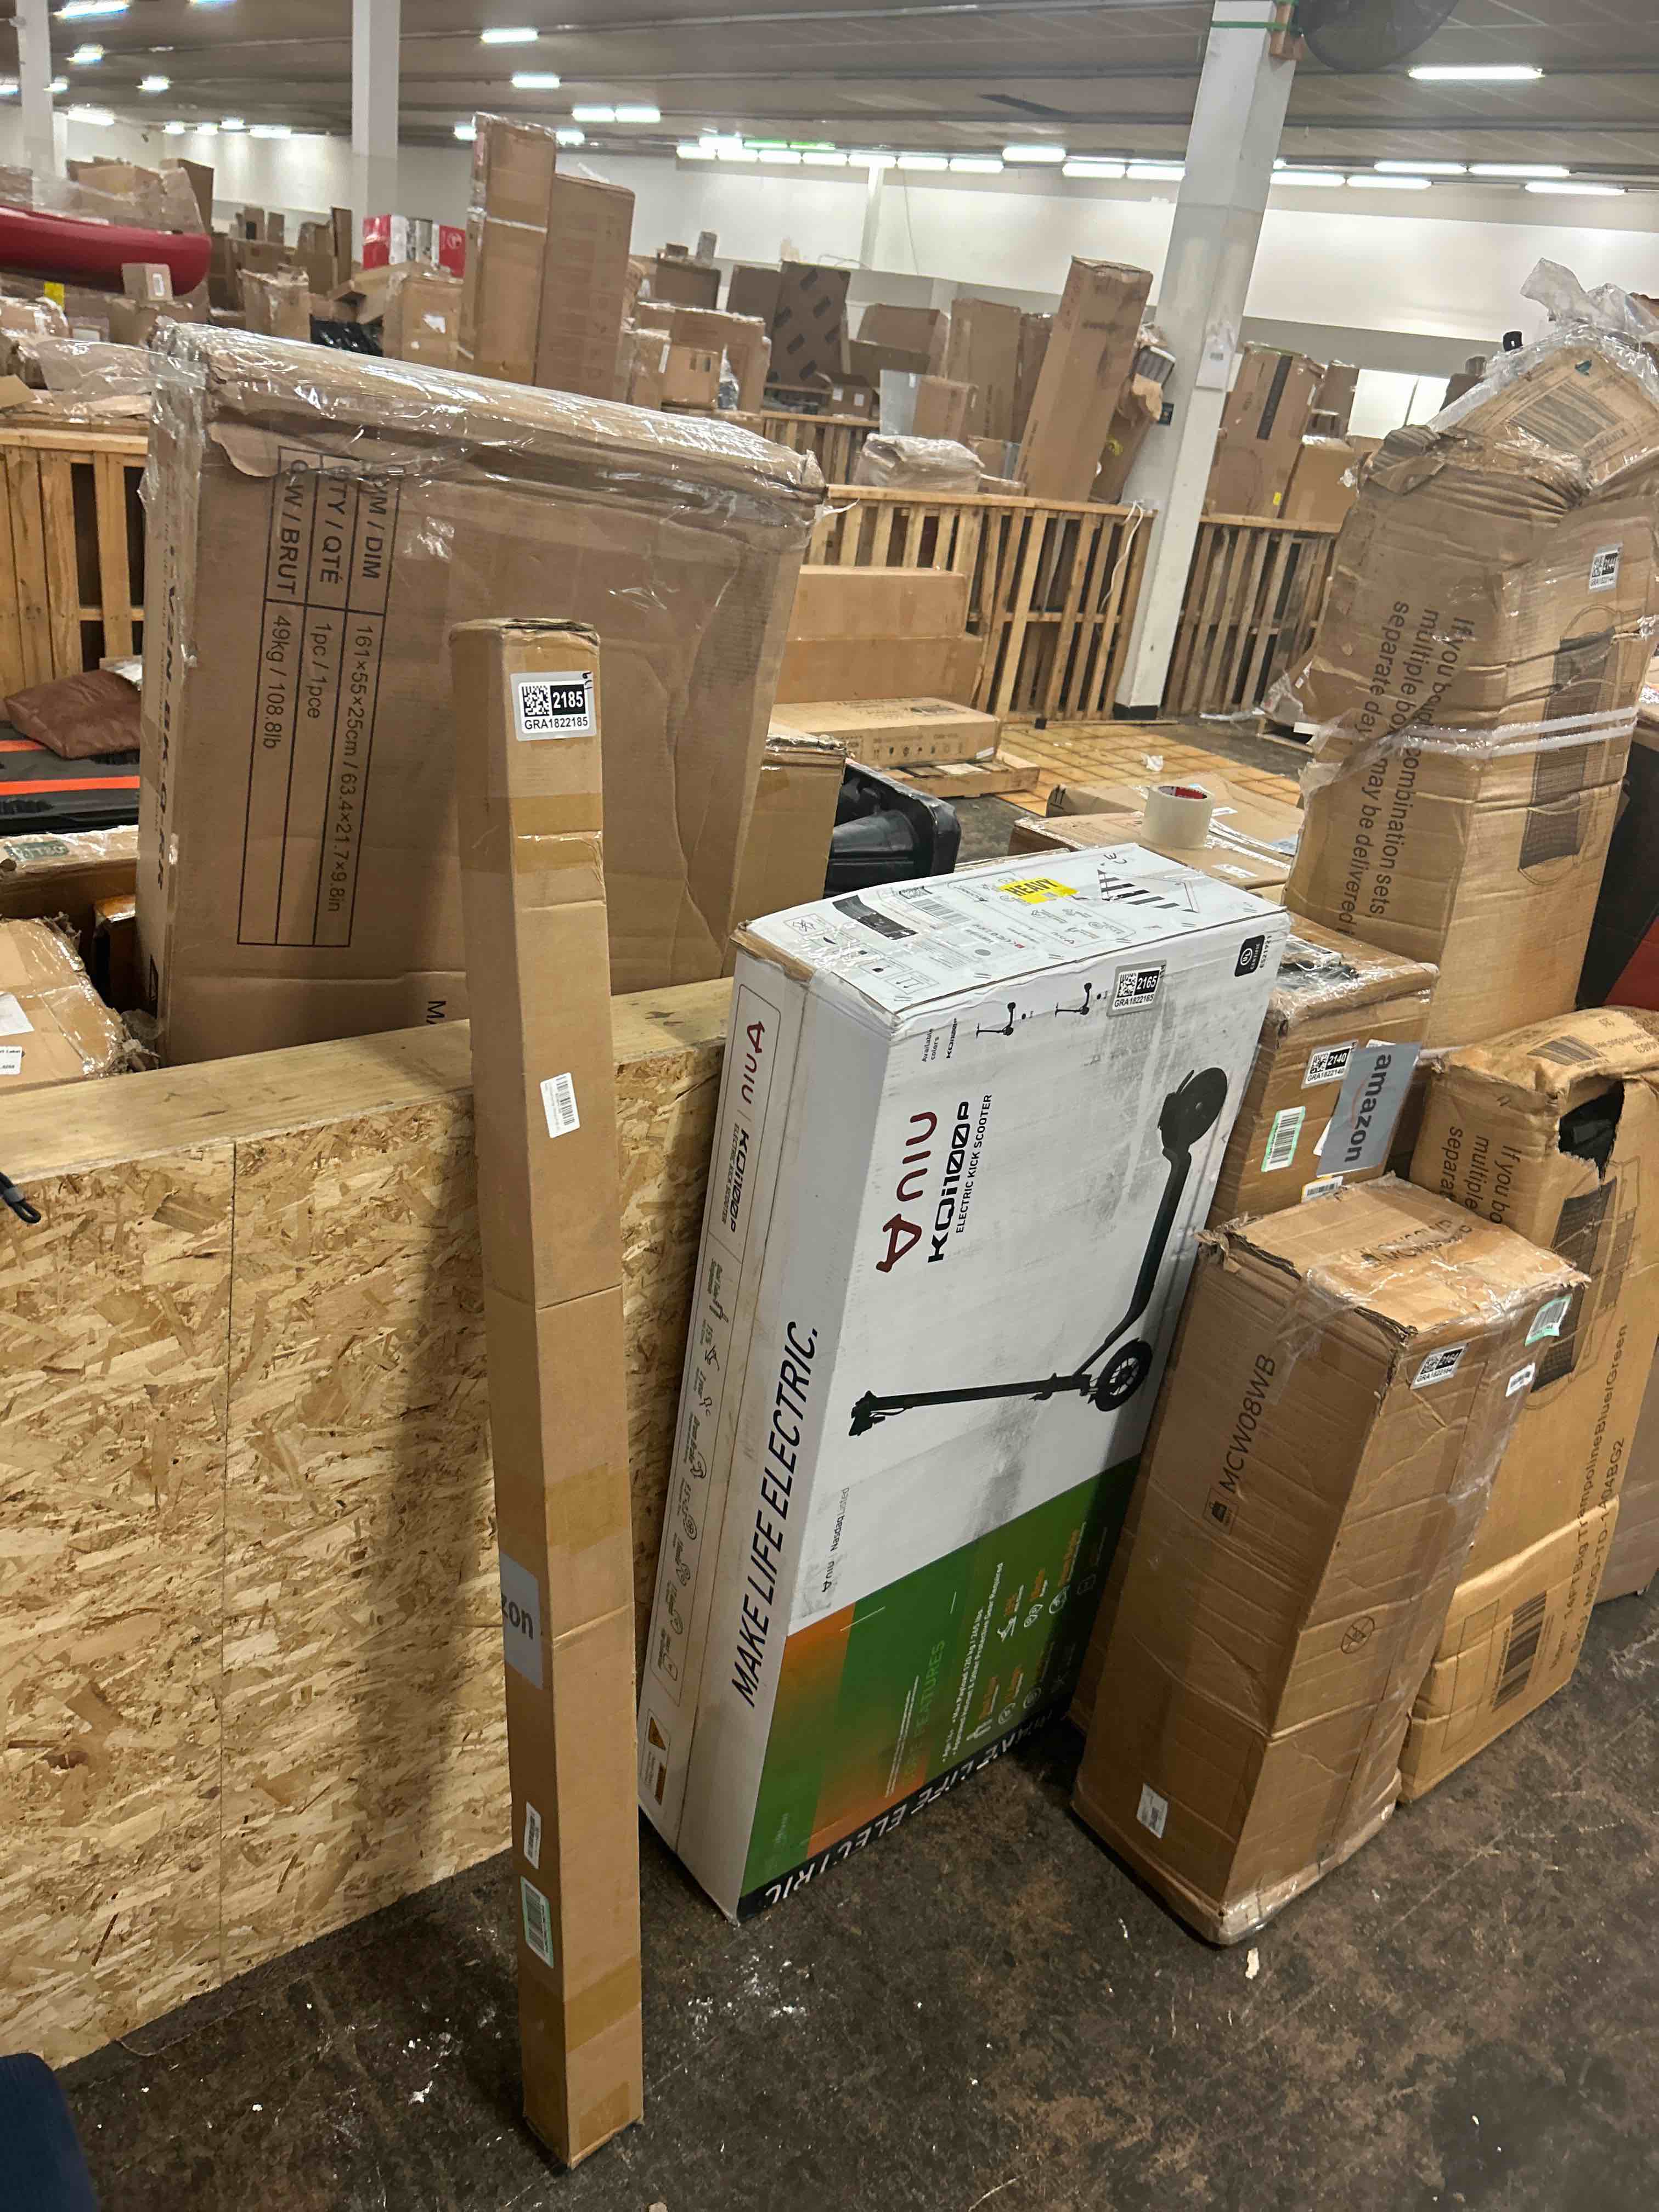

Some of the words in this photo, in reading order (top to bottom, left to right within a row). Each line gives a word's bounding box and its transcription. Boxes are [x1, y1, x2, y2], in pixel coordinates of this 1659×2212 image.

[276, 527, 300, 595] BRUT
[320, 536, 343, 584] QTÉ
[362, 537, 383, 579] DIM
[266, 615, 291, 664] 49kg
[310, 623, 332, 657] 1pc
[1370, 601, 1409, 696] separate
[1453, 617, 1475, 636] If
[1401, 608, 1439, 695] multiple
[1436, 637, 1460, 678] you
[262, 682, 286, 750] 108.8lb
[307, 675, 328, 720] 1pce
[552, 691, 583, 709] 2185
[1354, 701, 1384, 735] day
[525, 716, 588, 730] GRA1822185
[1359, 805, 1381, 829] be
[1381, 748, 1421, 868] combination
[1006, 878, 1058, 896] HEAVY
[1338, 833, 1374, 925] delivered
[1114, 994, 1154, 1007] GRA1822165
[1137, 976, 1158, 990] 2165
[1328, 1052, 1347, 1065] 2140
[1345, 1054, 1392, 1163] amazon
[956, 1183, 973, 1234] ELECTRIC
[967, 1151, 980, 1182] KICK
[974, 1094, 992, 1149] SCOOTER
[1463, 1135, 1489, 1211] multiple
[1503, 1146, 1522, 1163] If
[928, 1101, 970, 1263] KQi100P
[1494, 1160, 1514, 1198] you
[761, 1321, 818, 1520] ELECTRIC.
[1218, 1354, 1276, 1494] MCW08WB
[747, 1510, 784, 1606] LIFE
[732, 1594, 770, 1709] MAKE
